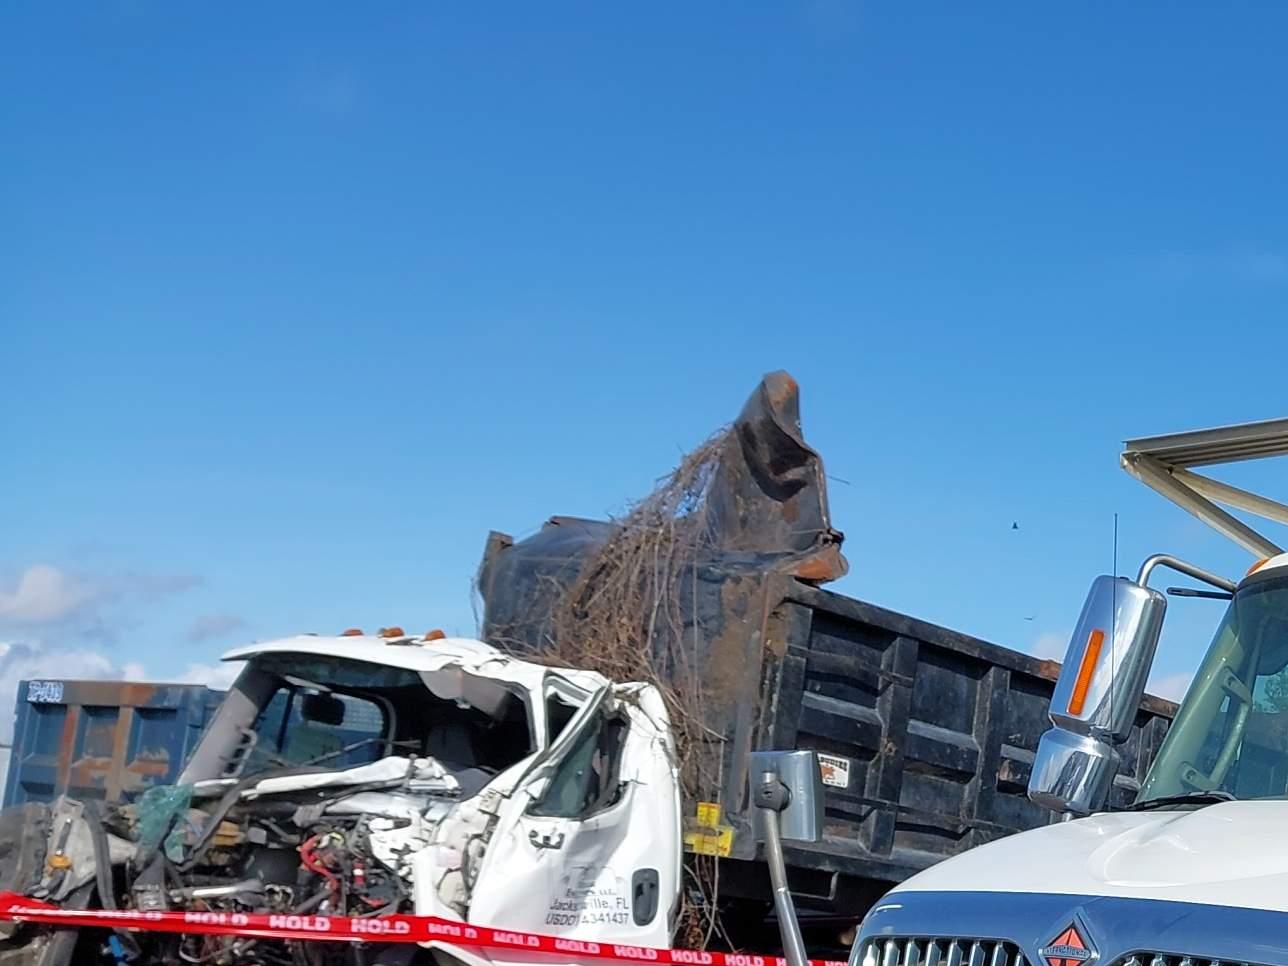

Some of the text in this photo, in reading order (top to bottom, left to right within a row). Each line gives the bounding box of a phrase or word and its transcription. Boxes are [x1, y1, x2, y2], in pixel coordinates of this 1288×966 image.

[616, 897, 629, 910] FL
[269, 914, 331, 932] HOLD
[351, 918, 410, 935] HOLD
[493, 930, 540, 948] HOLD
[555, 938, 600, 954] HOLD
[614, 944, 657, 960] HOLD
[671, 949, 712, 965] HOLD
